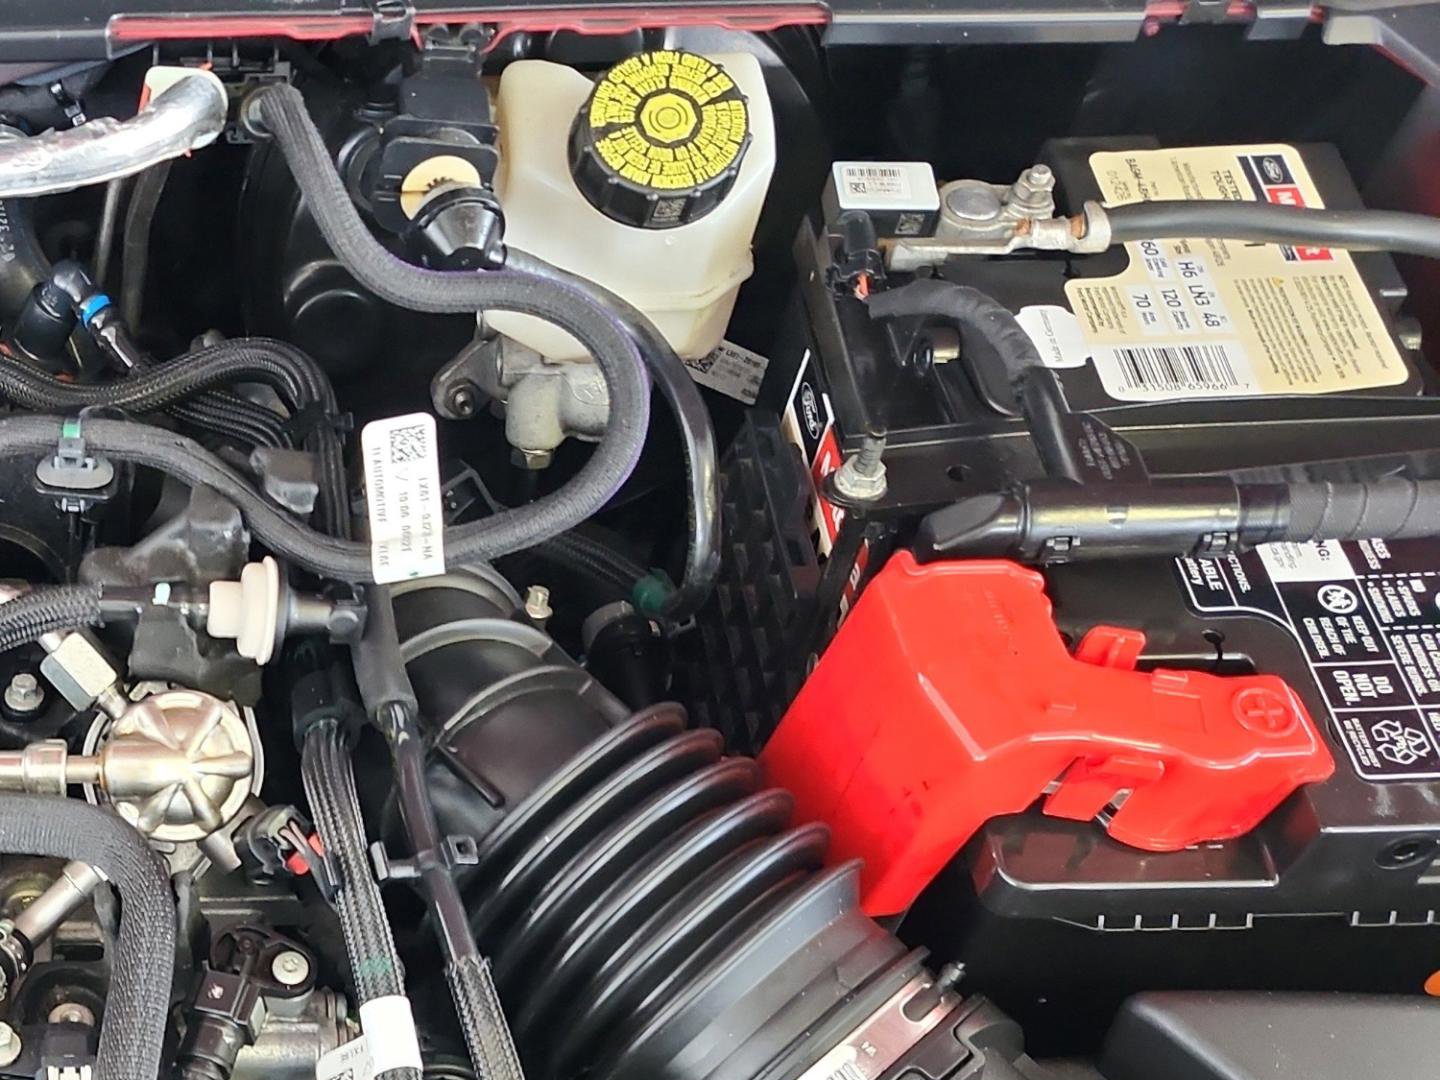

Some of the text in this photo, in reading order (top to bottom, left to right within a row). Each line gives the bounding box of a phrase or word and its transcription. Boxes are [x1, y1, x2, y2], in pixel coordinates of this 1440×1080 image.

[1141, 241, 1158, 256] 60
[1133, 294, 1151, 309] 70
[1161, 289, 1181, 308] 120
[1178, 261, 1220, 327] H6 LN3 48
[1185, 558, 1204, 586] attery
[1319, 617, 1339, 643] REACH
[1352, 616, 1380, 653] KEEP OUT
[1391, 635, 1413, 665] SEVERE
[1333, 670, 1360, 706] OPEN.
[1352, 673, 1378, 698] NOT
[1372, 676, 1394, 694] DO
